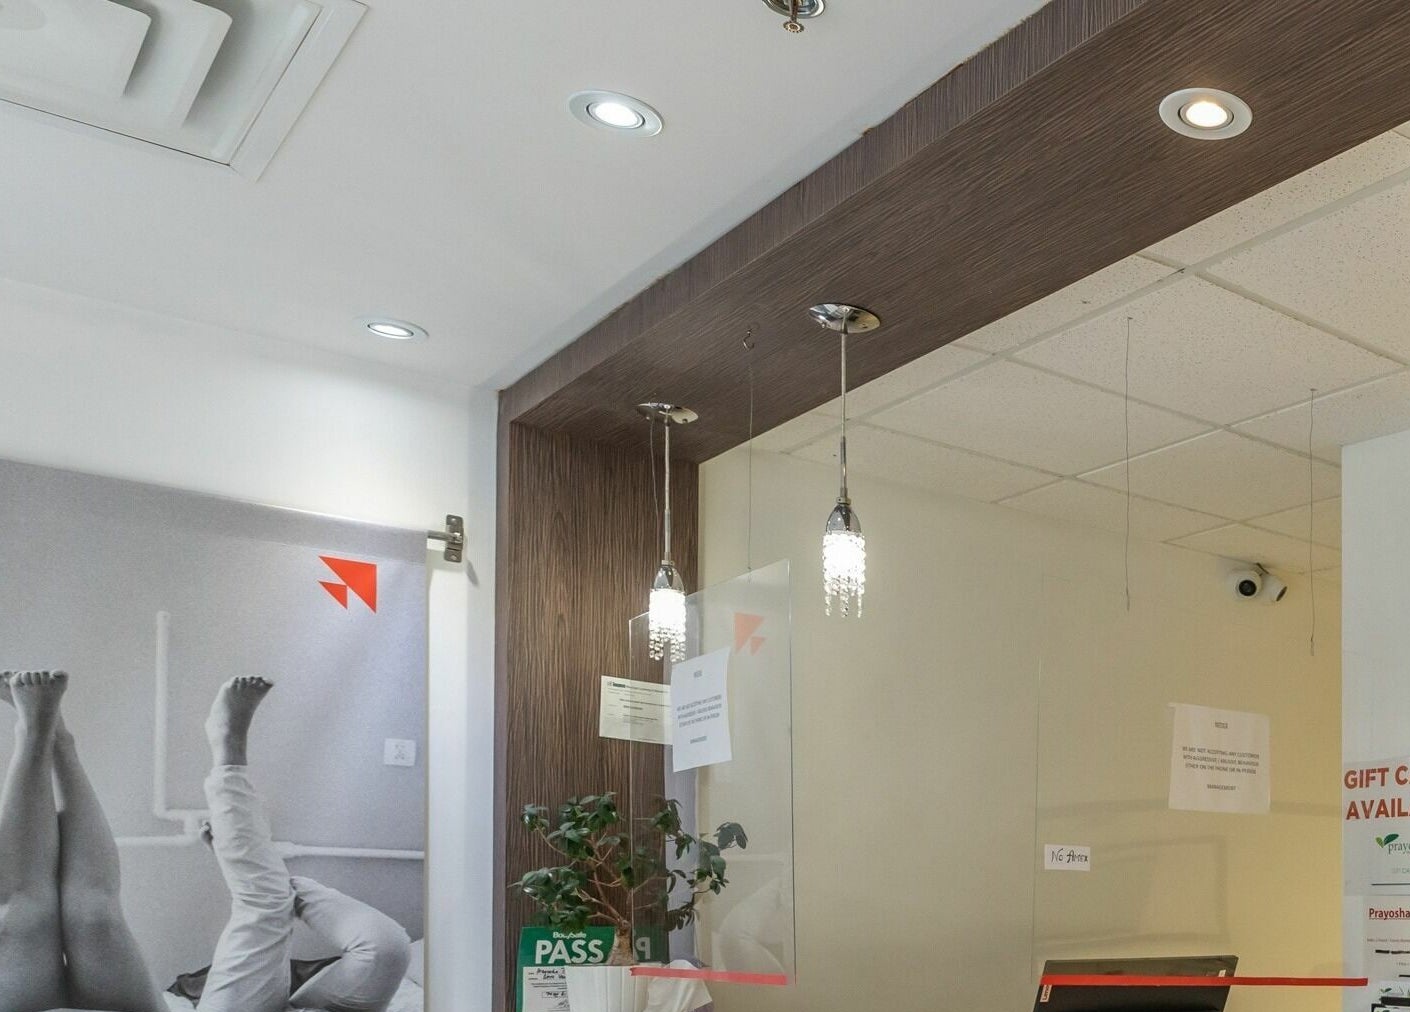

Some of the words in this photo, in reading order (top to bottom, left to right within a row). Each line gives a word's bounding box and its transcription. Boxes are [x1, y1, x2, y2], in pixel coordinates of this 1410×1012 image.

[1343, 767, 1390, 790] GIFT
[1368, 907, 1410, 921] Prayosha
[534, 939, 605, 965] PASS
